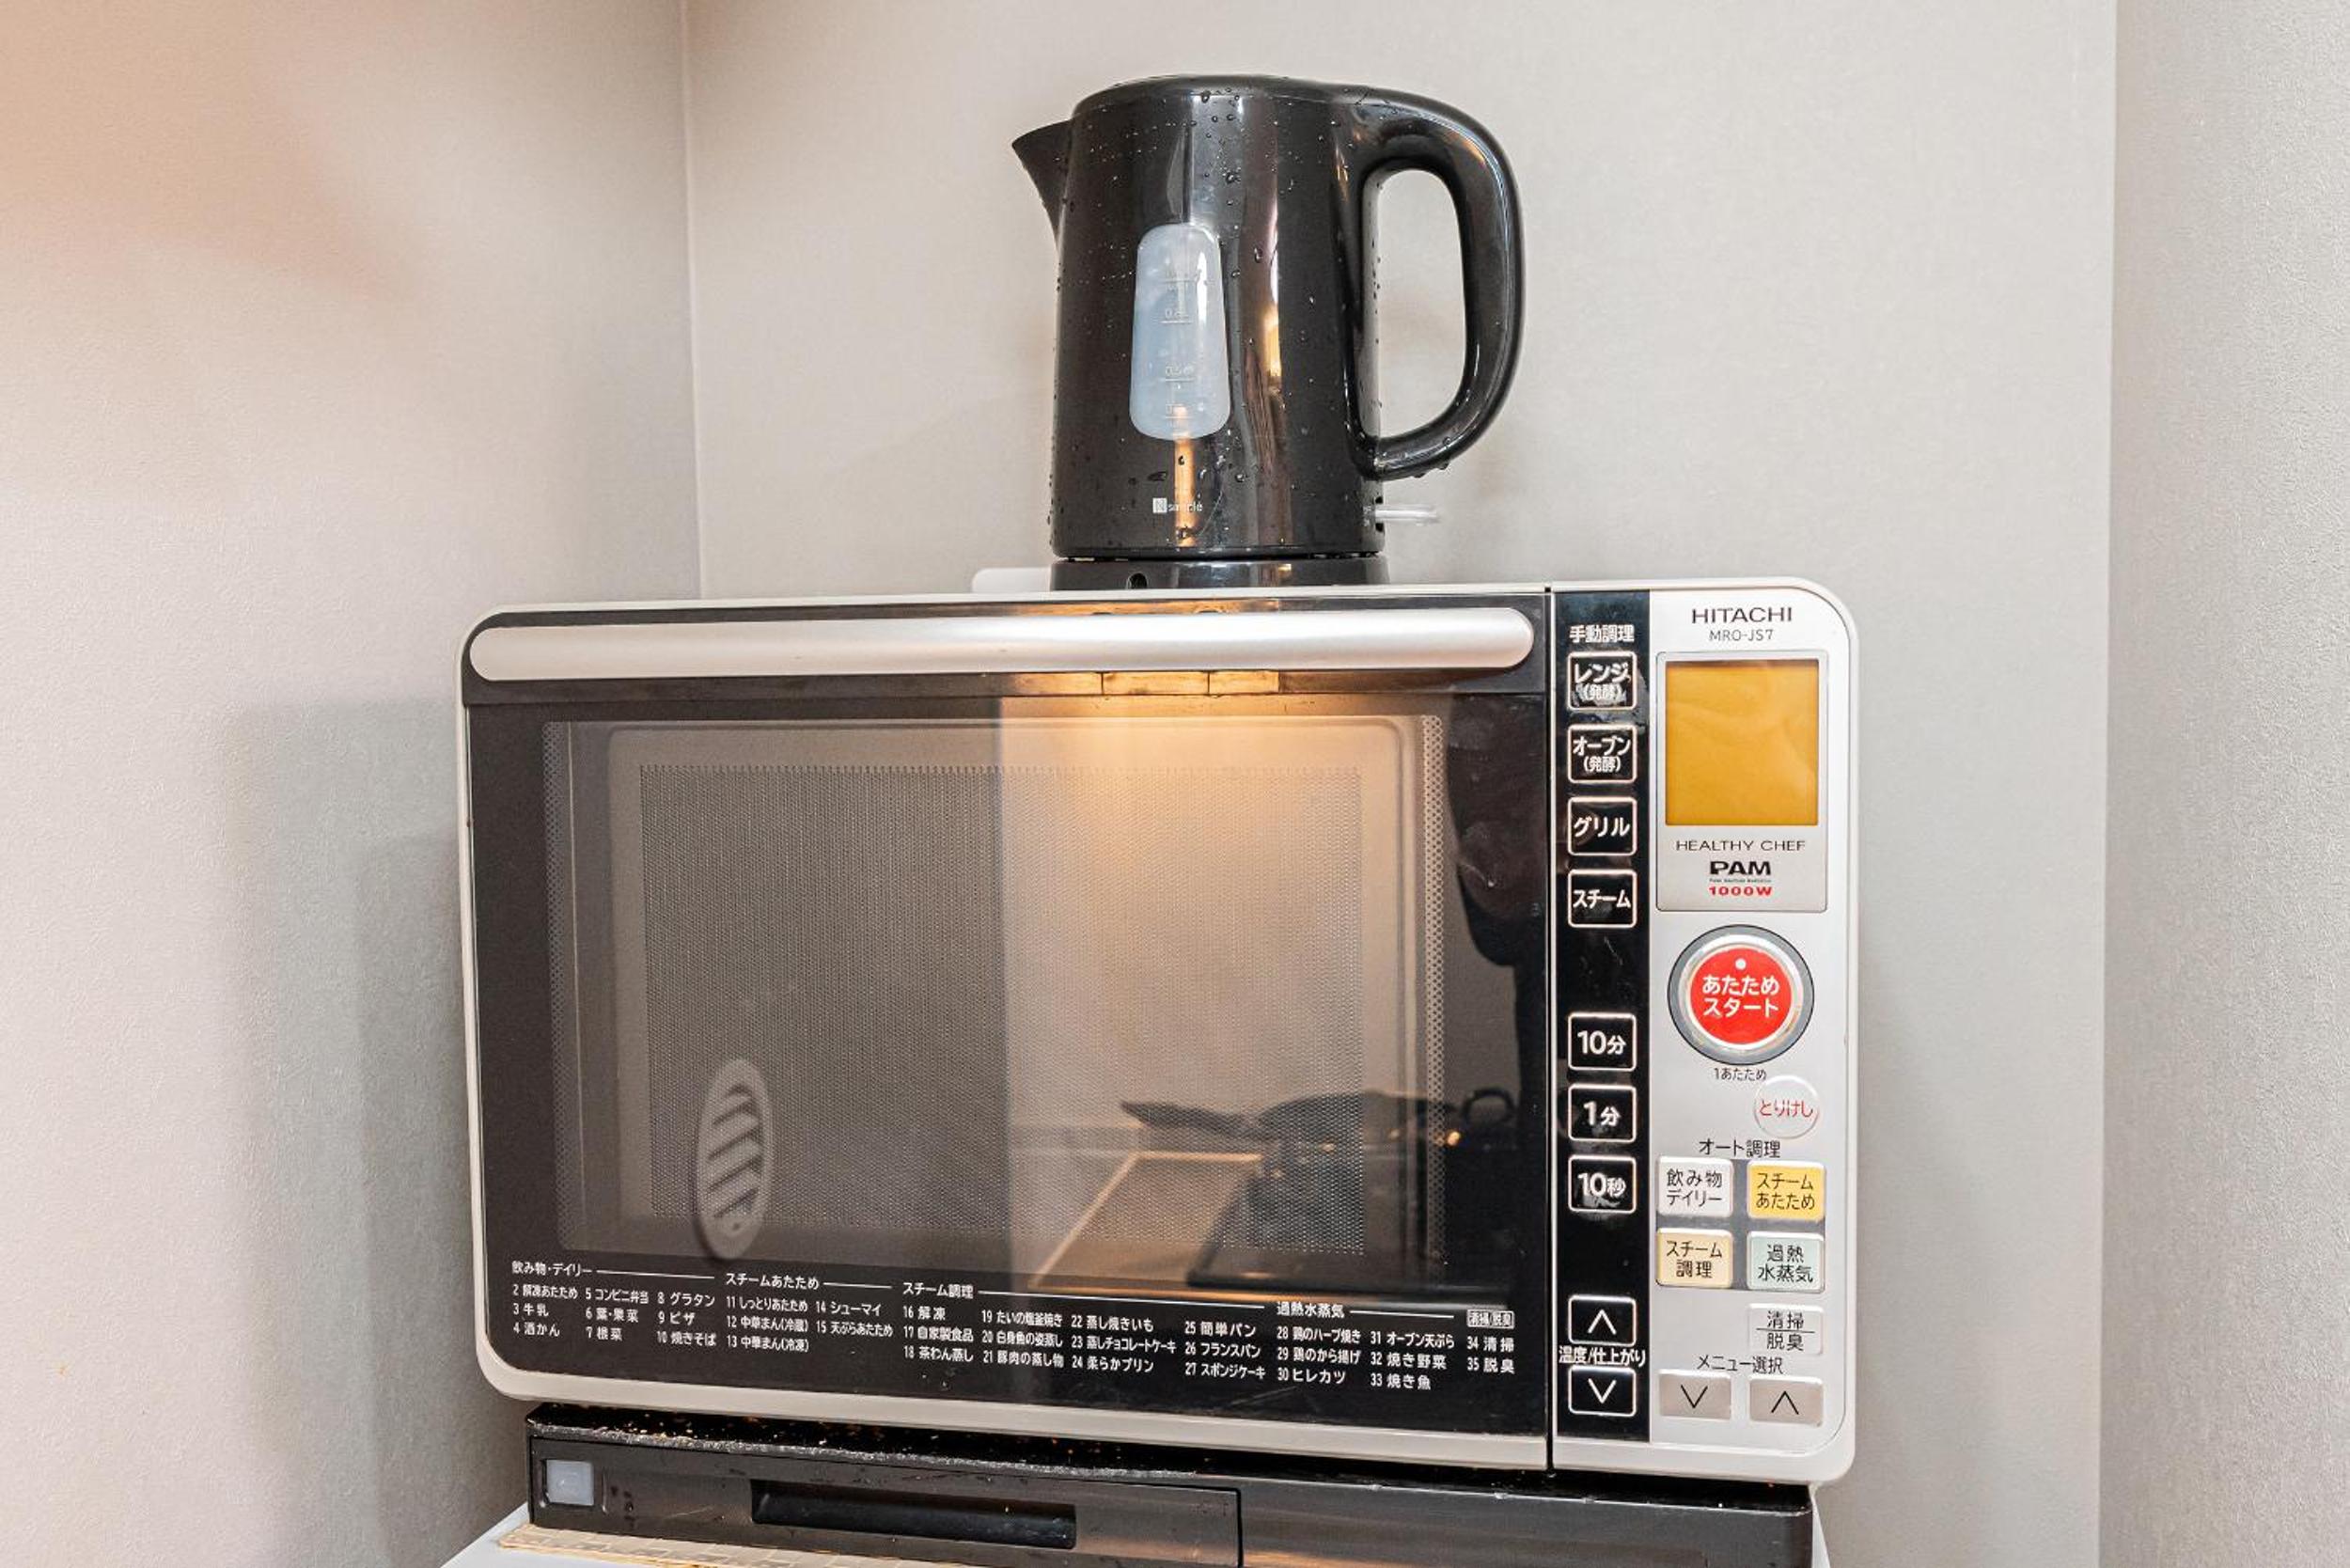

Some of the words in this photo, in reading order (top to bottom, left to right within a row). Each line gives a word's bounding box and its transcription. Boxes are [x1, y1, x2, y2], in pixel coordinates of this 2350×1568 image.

[1692, 607, 1792, 624] HITACHI
[1570, 624, 1635, 643] 手動調理
[1709, 629, 1774, 642] MRO-JS7
[1574, 662, 1631, 683] レンジ
[1573, 736, 1631, 757] オーブン
[1583, 756, 1622, 773] (発酵)
[1574, 817, 1631, 838] グリル
[1676, 840, 1754, 852] HEALTHY
[1761, 840, 1806, 852] CHEF
[1710, 861, 1771, 875] PAM
[1573, 889, 1631, 909] スチーム
[1709, 886, 1772, 897] 1000W
[1702, 975, 1780, 996] あたため
[1703, 997, 1779, 1018] スタート
[1577, 1030, 1627, 1055] 10分
[1715, 1068, 1767, 1081] 1あたため
[1583, 1102, 1622, 1126] 1分
[1760, 1100, 1814, 1118] とりけし
[1699, 1139, 1781, 1158] オート調理
[1577, 1172, 1627, 1198] 10秒
[1667, 1168, 1723, 1188] 飲み物
[1757, 1172, 1813, 1191] スチーム
[1667, 1189, 1722, 1208] デイリー
[1757, 1191, 1815, 1210] あたため
[1667, 1241, 1723, 1259] スチーム
[1767, 1244, 1805, 1263] 過熱
[1676, 1260, 1713, 1278] 調理
[1758, 1263, 1813, 1284] 水蒸気
[513, 1284, 519, 1295] 2
[726, 1273, 820, 1290] スチームあたため
[586, 1288, 592, 1299] 5
[595, 1289, 649, 1304] コンビニ弁当
[902, 1282, 974, 1299] スチーム調理
[658, 1293, 665, 1304] 8
[670, 1292, 715, 1308] グラタン
[727, 1296, 735, 1309] 11
[739, 1296, 807, 1312] しっとりあたため
[816, 1301, 826, 1313] 14
[830, 1302, 882, 1316] シューマイ
[513, 1303, 519, 1314] 3
[524, 1303, 549, 1317] 牛乳
[586, 1308, 592, 1319] 6
[658, 1312, 665, 1324] 9
[903, 1306, 914, 1319] 16
[917, 1306, 946, 1321] 解凍
[981, 1309, 993, 1324] 19
[1277, 1301, 1345, 1319] 過熱水蒸気
[727, 1316, 737, 1327] 12
[1071, 1315, 1083, 1328] 22
[1087, 1315, 1153, 1332] 蒸し焼きいも
[1767, 1310, 1805, 1329] 清掃
[513, 1322, 520, 1334] 4
[524, 1322, 560, 1337] 酒かん
[586, 1327, 592, 1339] 7
[597, 1326, 623, 1341] 根菜
[816, 1321, 826, 1333] 15
[831, 1322, 893, 1338] 天ぷらあたため
[903, 1325, 914, 1339] 17
[917, 1325, 974, 1342] 自家製食品
[982, 1329, 994, 1343] 20
[1184, 1321, 1196, 1335] 25
[1200, 1321, 1256, 1338] 簡単パン
[1277, 1326, 1289, 1340] 28
[657, 1331, 666, 1343] 10
[671, 1332, 717, 1347] 焼きそば
[727, 1336, 737, 1347] 13
[1072, 1336, 1083, 1348] 23
[1087, 1335, 1177, 1355] 蒸しチョコレートケーキ
[1371, 1331, 1381, 1344] 31
[1386, 1331, 1455, 1349] オーブン天ぷら
[1466, 1336, 1479, 1350] 34
[1483, 1336, 1514, 1353] 清掃
[1767, 1332, 1805, 1352] 脱臭
[903, 1345, 915, 1359] 18
[918, 1346, 974, 1362] 茶わん蒸し
[983, 1350, 993, 1363] 21
[997, 1350, 1064, 1368] 豚肉の蒸し物
[1184, 1342, 1196, 1356] 26
[1201, 1342, 1261, 1359] フランスパン
[1277, 1347, 1289, 1360] 29
[1293, 1347, 1361, 1365] 鶏のから揚げ
[1559, 1345, 1646, 1368] 温度/仕上がり
[1072, 1356, 1083, 1369] 24
[1087, 1356, 1154, 1373] 柔らかプリン
[1371, 1352, 1383, 1366] 32
[1386, 1352, 1447, 1370] 焼き野菜
[1467, 1356, 1480, 1371] 35
[1483, 1356, 1514, 1374] 脱臭
[1697, 1355, 1784, 1374] メニュー選択
[1185, 1363, 1196, 1375] 27
[1201, 1363, 1265, 1380] スポンジケーキ
[1277, 1367, 1289, 1381] 30
[1292, 1368, 1346, 1385] ヒレカツ
[1371, 1373, 1383, 1387] 33
[1386, 1373, 1431, 1390] 焼き魚
